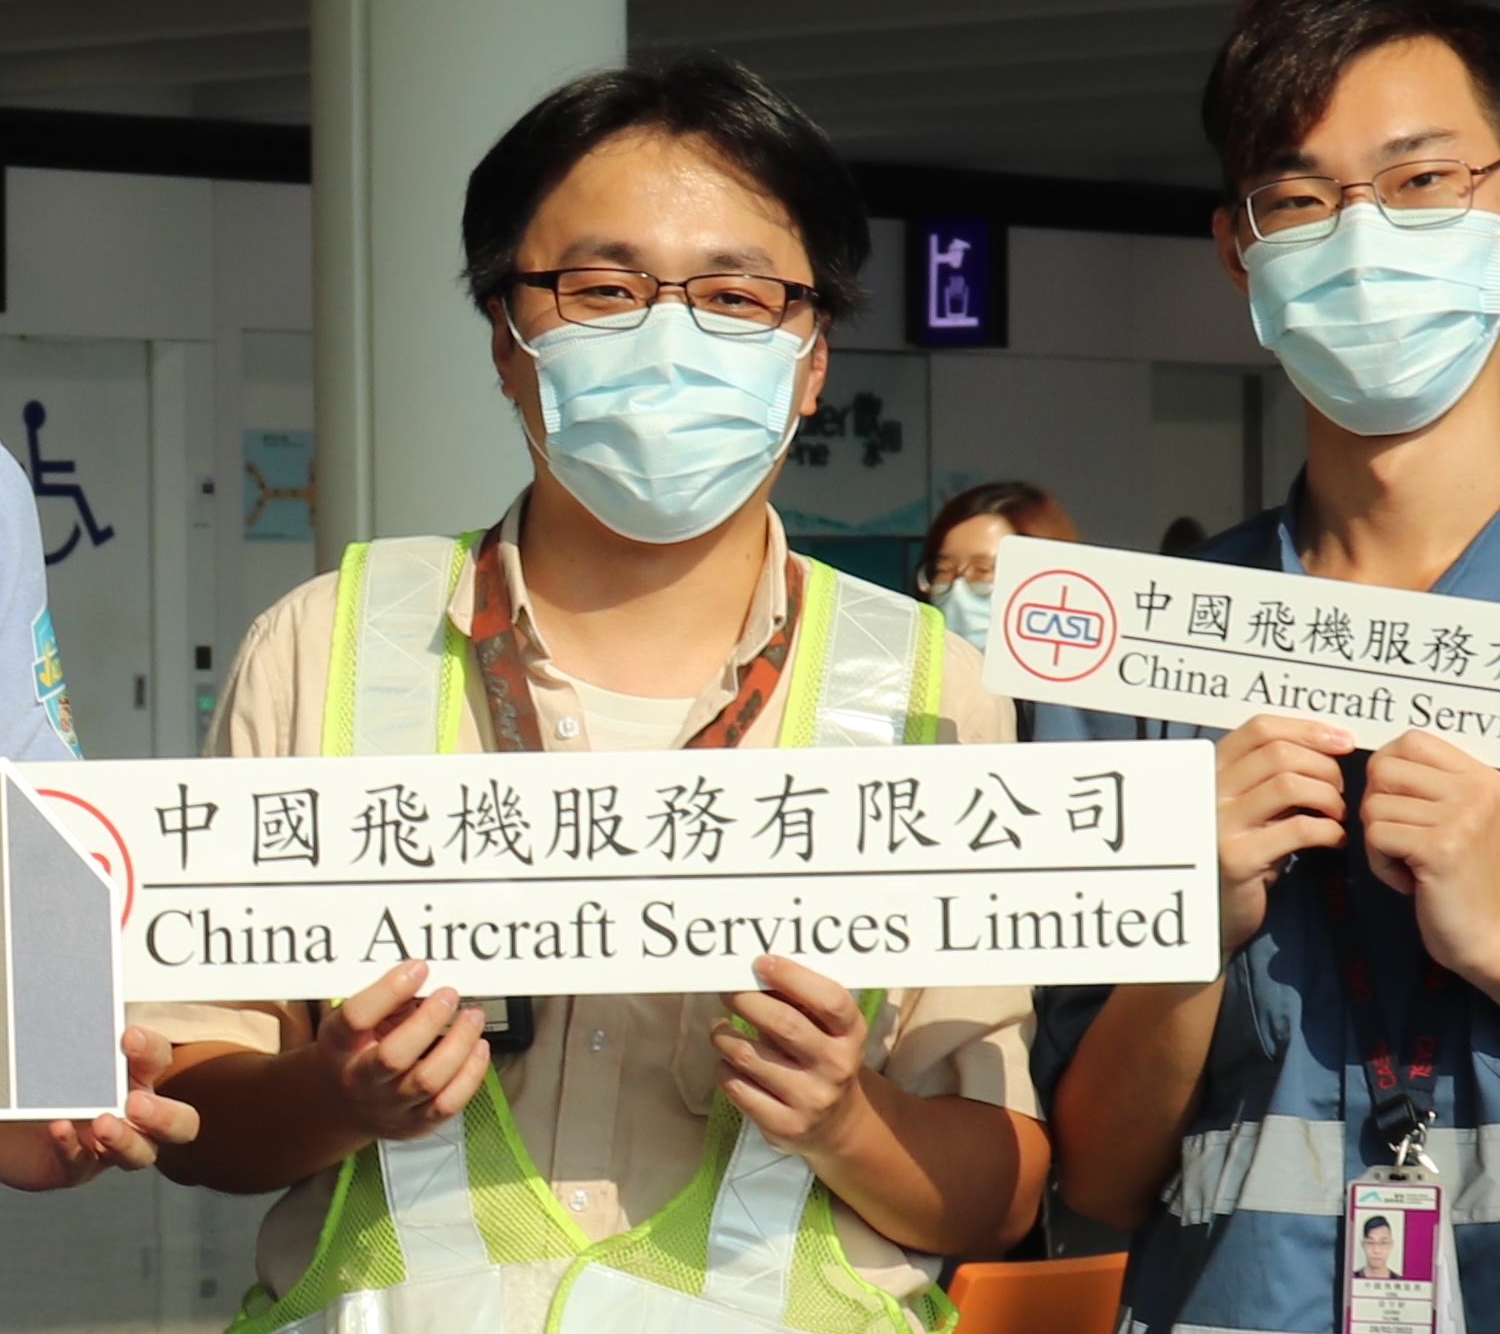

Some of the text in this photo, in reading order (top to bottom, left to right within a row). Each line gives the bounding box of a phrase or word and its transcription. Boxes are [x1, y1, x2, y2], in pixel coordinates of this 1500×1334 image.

[1025, 609, 1099, 642] CASL
[1118, 651, 1230, 700] China
[1241, 670, 1397, 723] Aircraft
[154, 770, 1126, 871] 中國飛機服務有限公司
[145, 889, 1190, 967] China Aircraft Services Limited
